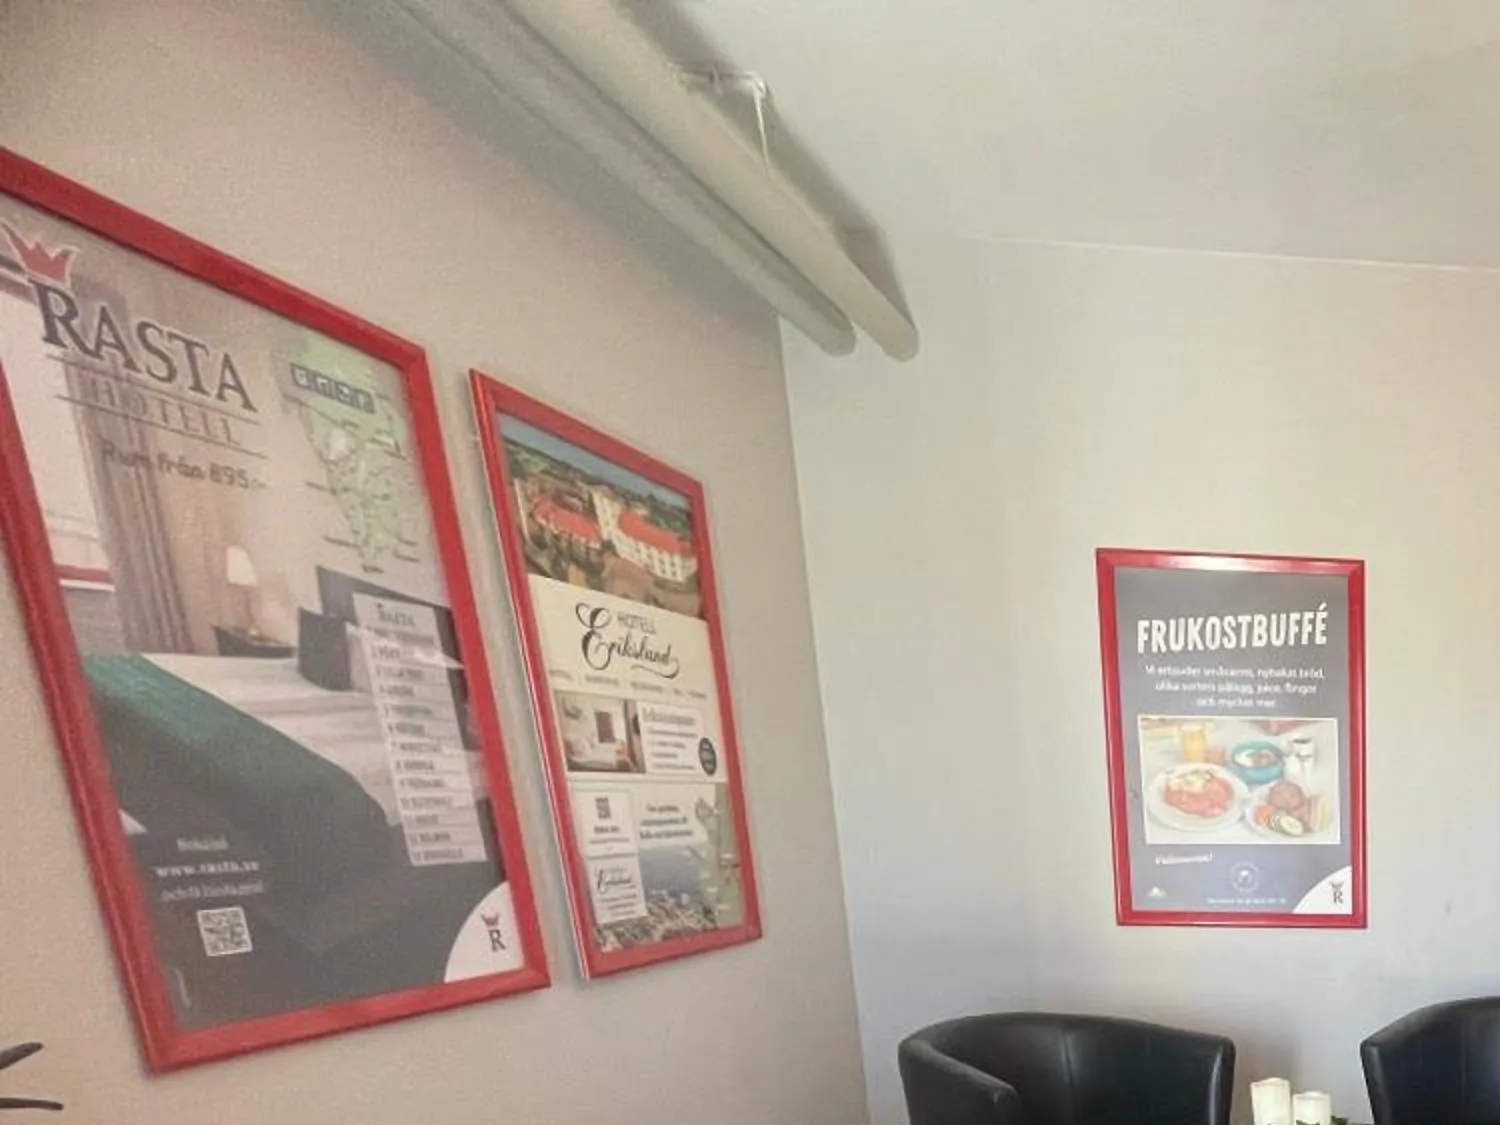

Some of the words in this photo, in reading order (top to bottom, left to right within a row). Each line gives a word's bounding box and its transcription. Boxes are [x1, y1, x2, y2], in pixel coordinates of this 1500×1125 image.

[28, 278, 258, 413] RASTA
[1137, 602, 1329, 654] FRUKOSTBUFFÉ
[489, 929, 506, 952] R
